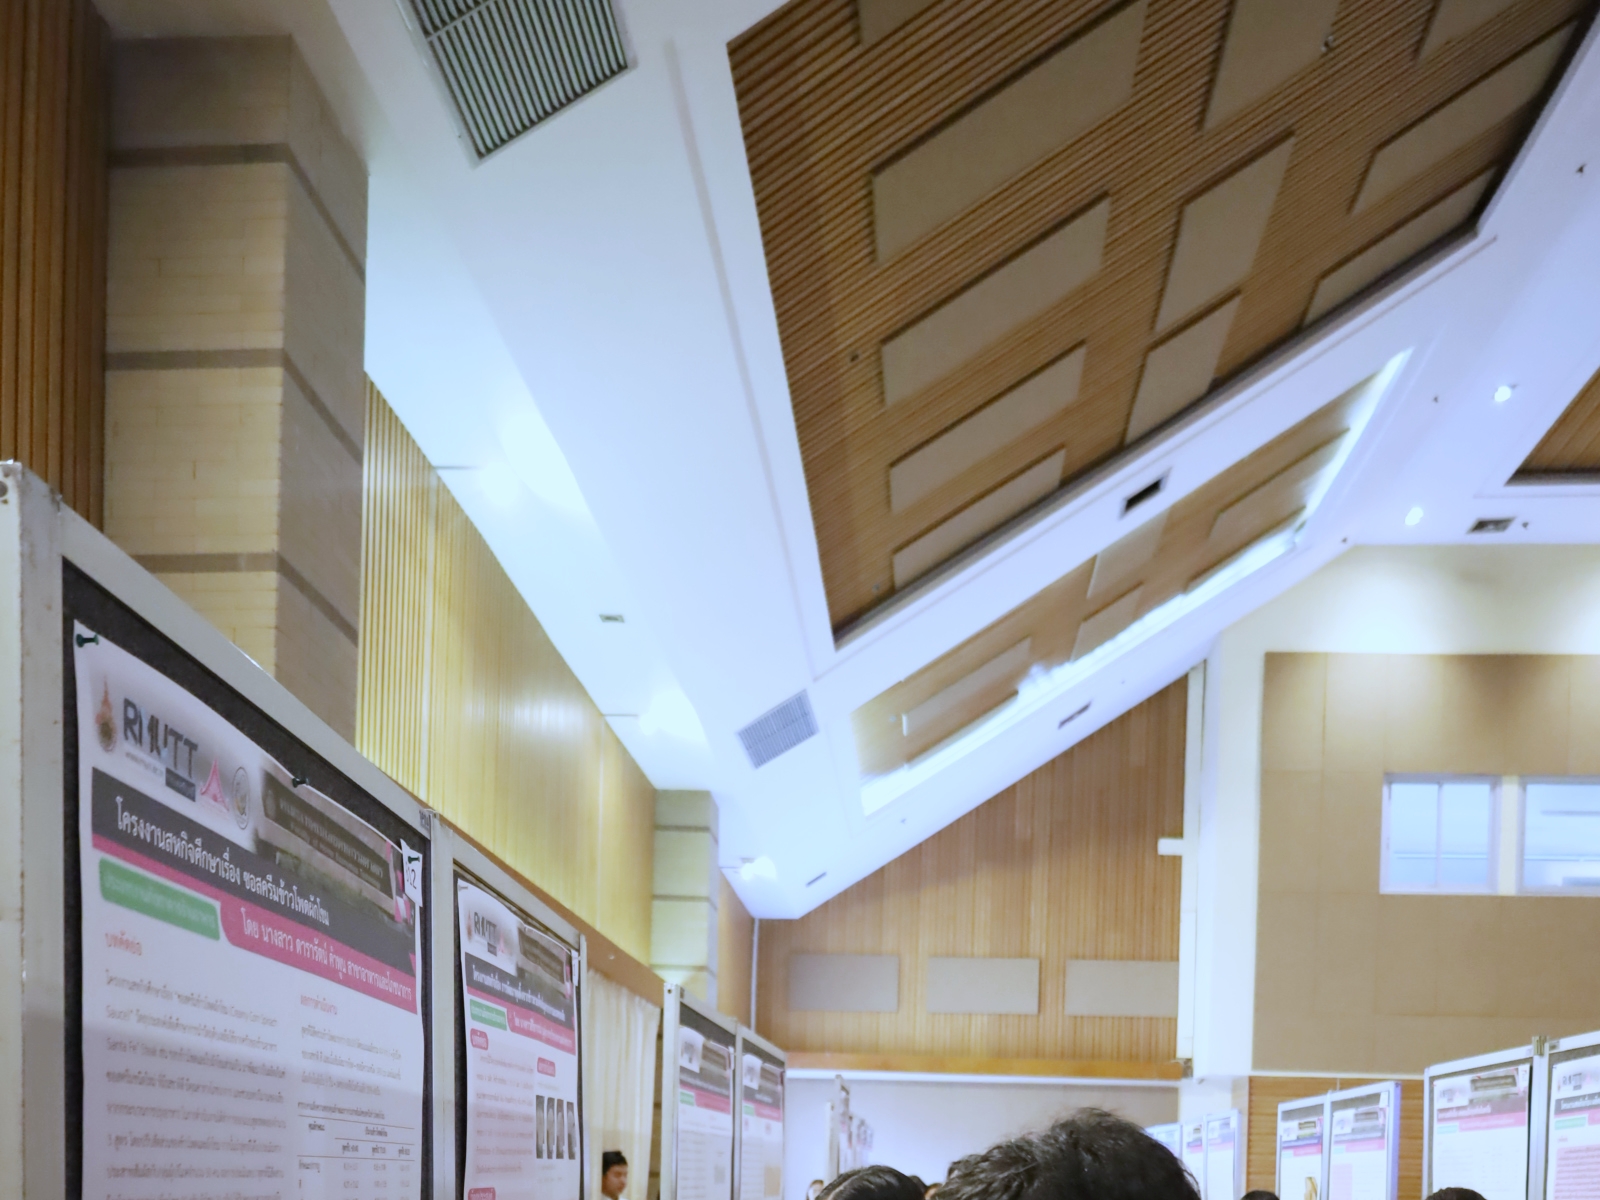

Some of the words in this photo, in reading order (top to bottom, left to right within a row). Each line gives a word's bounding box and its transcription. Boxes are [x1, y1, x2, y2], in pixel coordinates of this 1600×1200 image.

[124, 698, 198, 778] RMUTT
[115, 795, 241, 885] โครงงานสหกิจศึกษาเรื่อง
[240, 907, 259, 939] โดย
[261, 924, 294, 953] นางสาว
